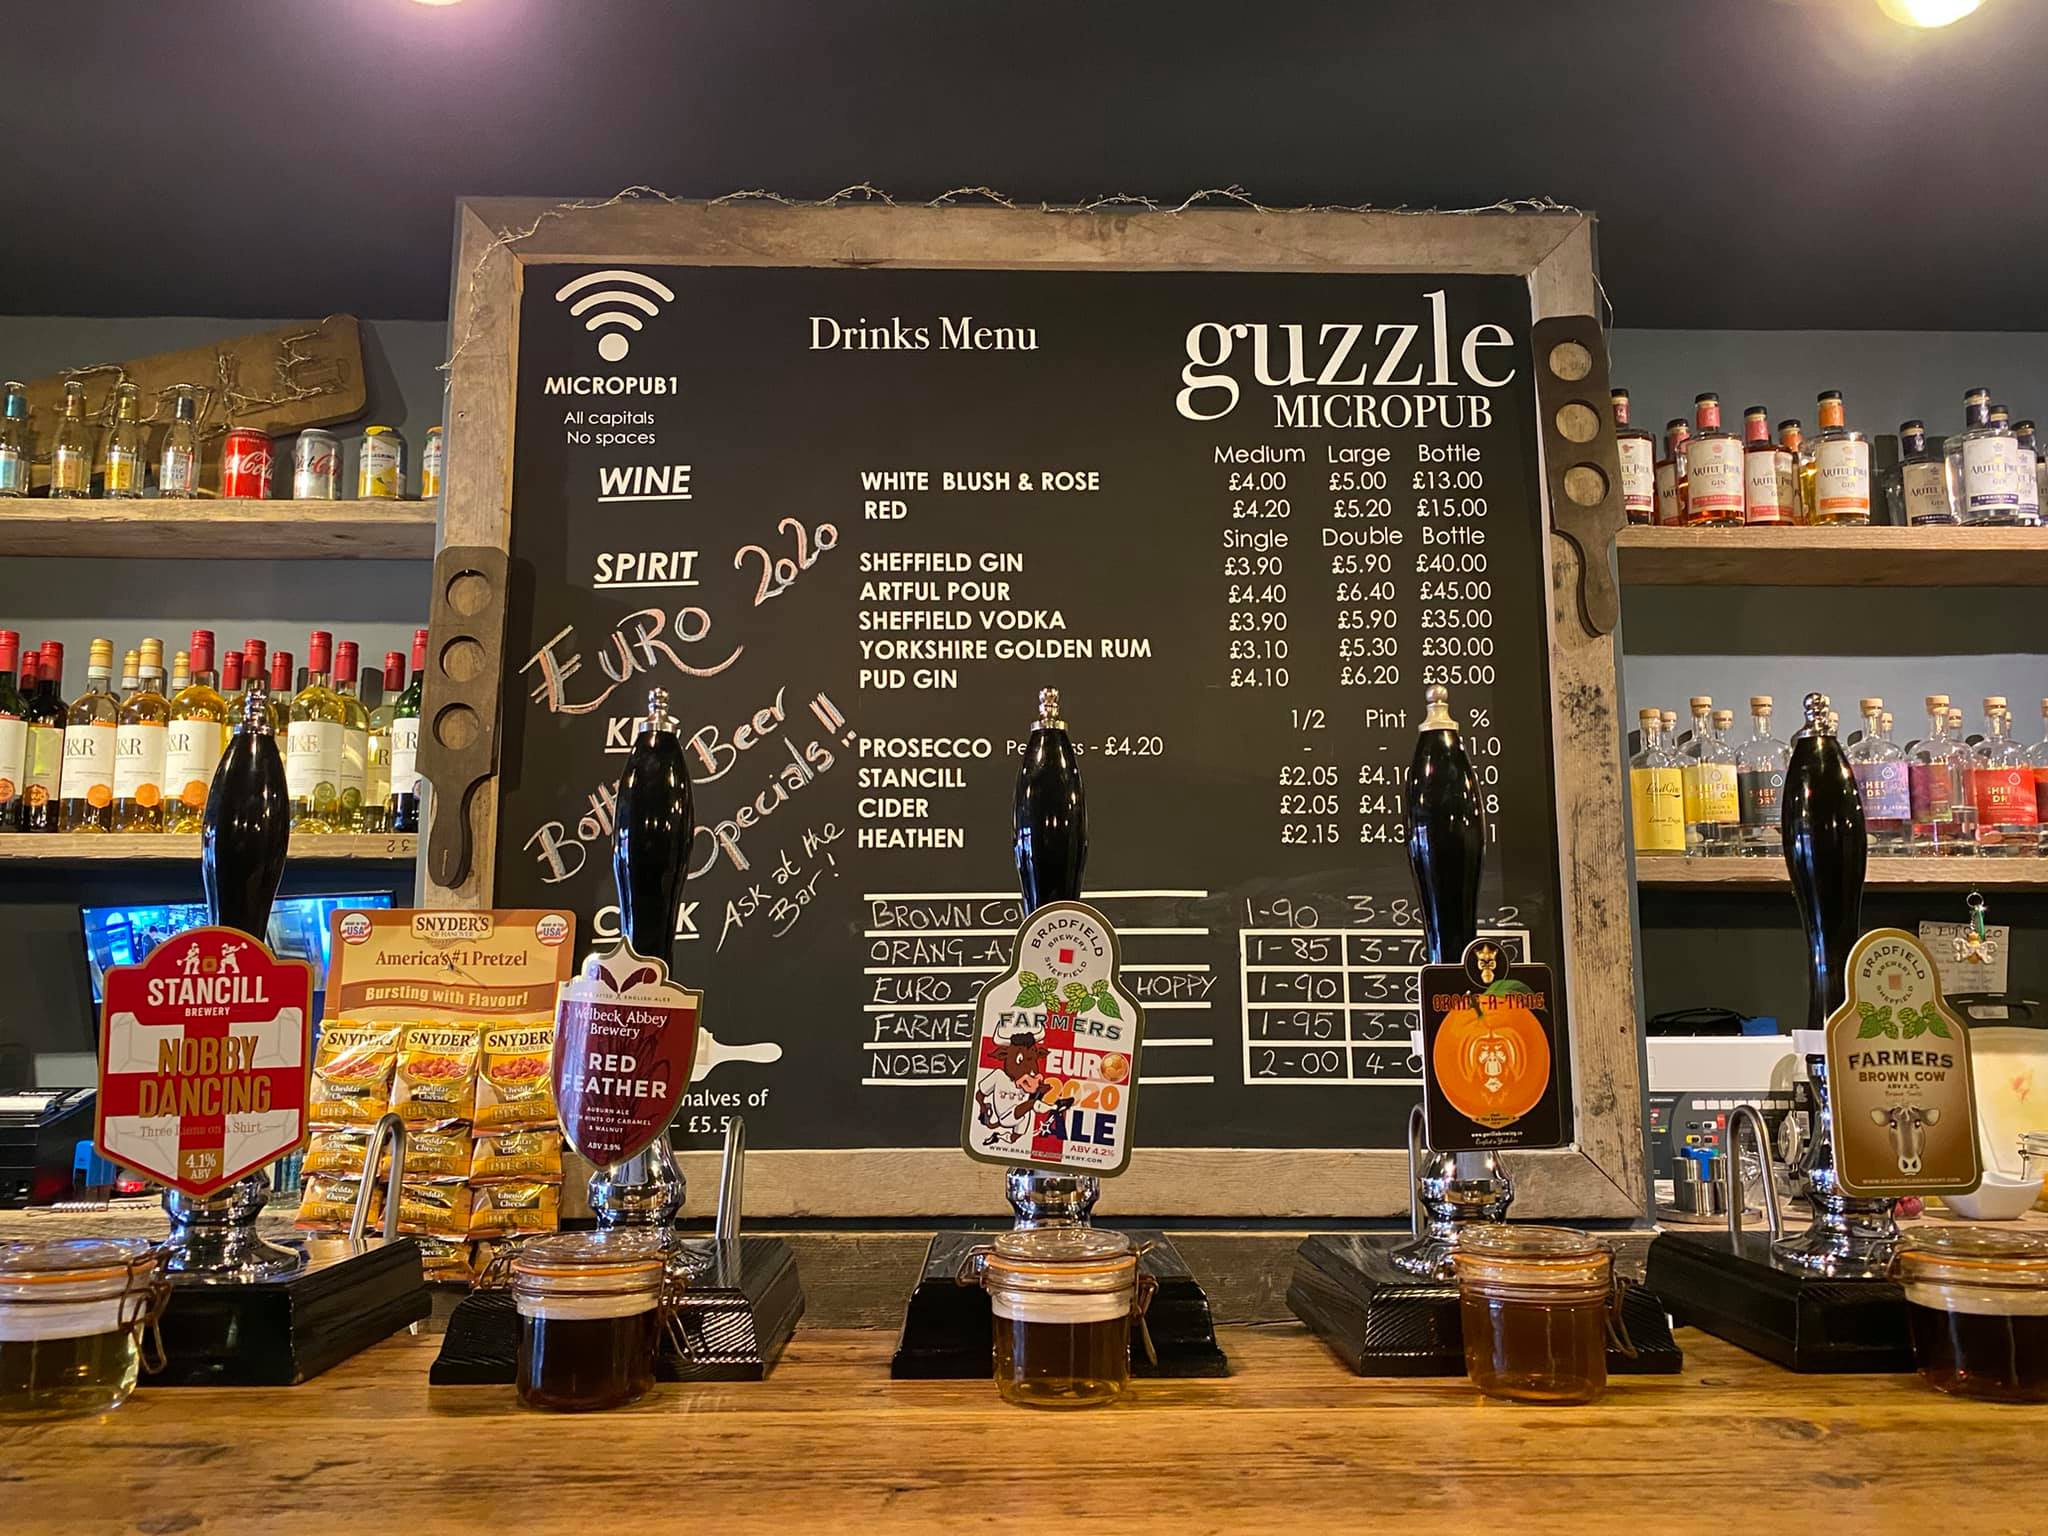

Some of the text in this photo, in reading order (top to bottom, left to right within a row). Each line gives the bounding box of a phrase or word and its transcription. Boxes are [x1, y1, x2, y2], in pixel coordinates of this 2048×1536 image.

[810, 317, 1038, 349] Drinks Menu
[1176, 290, 1516, 420] guzzle
[545, 377, 676, 394] MICROPUB1
[564, 411, 655, 430] All capitals
[1274, 395, 1491, 428] MICROPUB
[568, 432, 655, 446] No spaces
[1215, 444, 1480, 466] Medium Large Bottle
[598, 466, 692, 494] WINE
[861, 472, 1099, 490] WHITE BLUSH & ROSE
[1229, 471, 1482, 490] £4.00 £5.00 £13.00
[865, 501, 907, 519] RED
[1233, 499, 1487, 518] £4.20 £5.20 £15.00
[1224, 526, 1484, 551] Single Double Bottle
[594, 552, 697, 582] SPIRIT
[860, 553, 1022, 571] SHEFFIELD GIN
[1225, 554, 1486, 575] £3.90 £5.90 £40.00
[860, 582, 1010, 600] ARTFUL POUR
[1229, 581, 1491, 603] £4.40 £6.40 £45.00
[519, 517, 838, 714] EURO 2020
[859, 611, 1066, 630] SHEFFIELD VODKA
[1229, 609, 1492, 631] £3.90 £5.90 £35.00
[860, 639, 1151, 659] YORKSHIRE GOLDEN RUM
[1230, 638, 1493, 659] £3.10 £5.30 £30.00
[860, 670, 956, 688] PUD GIN
[1231, 666, 1494, 687] £4.10 £6.20 £35.00
[1292, 709, 1489, 730] 1/2 Pint %
[858, 738, 992, 758] PROSECCO
[1006, 740, 1027, 755] Pe
[1105, 737, 1163, 756] £4.20
[524, 686, 785, 883] Bott Beer
[859, 768, 966, 787] STANCILL
[1280, 767, 1338, 786] £2.05
[859, 799, 928, 817] CIDER
[1280, 795, 1402, 815] £2.05 £4.1
[859, 829, 963, 848] HEATHEN
[1281, 825, 1405, 844] £2.15 £4.3
[772, 850, 800, 884] at
[803, 823, 845, 858] the
[872, 901, 1024, 929] BROWN Co
[1245, 898, 1317, 929] 1-90
[347, 927, 364, 936] USA
[416, 916, 489, 932] SNYDER'S
[543, 928, 561, 936] USA
[1031, 919, 1104, 958] BRADFIELD
[1047, 933, 1089, 952] BREWERY
[376, 950, 527, 966] America's #1 Pretzel
[871, 938, 963, 966] ORANG
[1257, 937, 1330, 962] 1-85
[1044, 955, 1088, 979] SHEFFIELD
[1862, 945, 1925, 980] BRADFIELD
[1876, 960, 1911, 976] BREWERY
[147, 975, 268, 1006] STANCILL
[873, 977, 951, 1003] EURO
[1137, 973, 1217, 998] HOPPY
[1260, 974, 1336, 1001] 1-90
[365, 987, 528, 1007] Bursting with Flavour!
[185, 1007, 230, 1017] BREWERY
[627, 1012, 667, 1027] Abbey
[590, 1024, 640, 1040] Brewery
[874, 1013, 975, 1041] FARME
[999, 1011, 1122, 1041] FARMERS
[1262, 1011, 1333, 1039] 1-95
[158, 1035, 259, 1078] NOBBY
[589, 1053, 637, 1073] RED
[872, 1052, 967, 1077] NOBBY
[1259, 1049, 1339, 1076] 2-00
[1849, 1051, 1953, 1071] FARMERS
[1859, 1071, 1946, 1081] BROWN COW
[139, 1075, 272, 1118] DANCING
[562, 1075, 667, 1099] FEATHER
[748, 1088, 769, 1106] of
[1043, 1078, 1120, 1112] 2020
[587, 1106, 614, 1114] AUBURN
[141, 1126, 172, 1138] Three
[233, 1121, 261, 1134] Shirt
[1046, 1109, 1117, 1146] ALE
[587, 1142, 602, 1150] ABV
[1070, 1144, 1090, 1157] ABV
[1092, 1147, 1115, 1158] 4.2%
[185, 1153, 217, 1167] 4.1%
[190, 1168, 211, 1179] ABV
